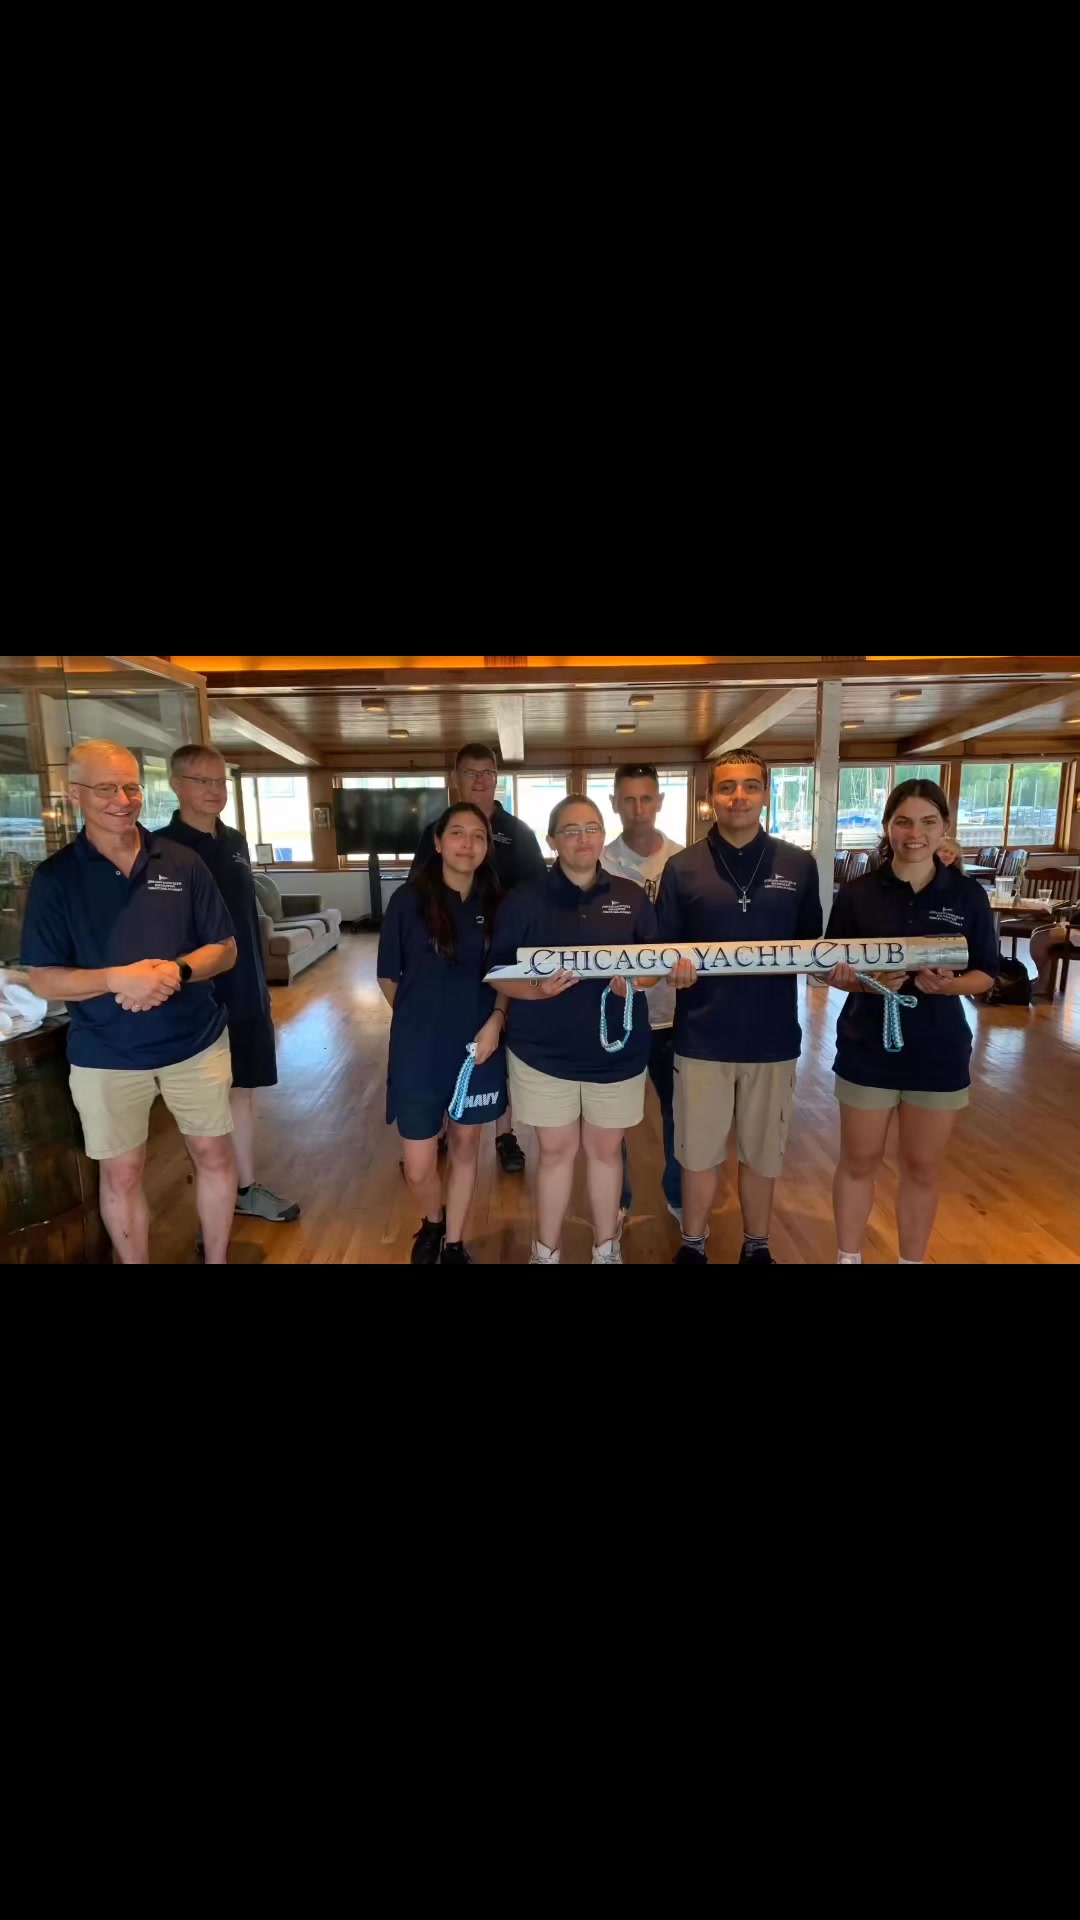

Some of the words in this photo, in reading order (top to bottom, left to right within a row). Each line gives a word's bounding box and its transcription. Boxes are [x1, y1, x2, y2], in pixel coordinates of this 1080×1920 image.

[524, 947, 682, 975] CHICAGO
[692, 944, 801, 971] YACHT
[804, 941, 905, 968] CLUB
[463, 1090, 499, 1109] NAVY
